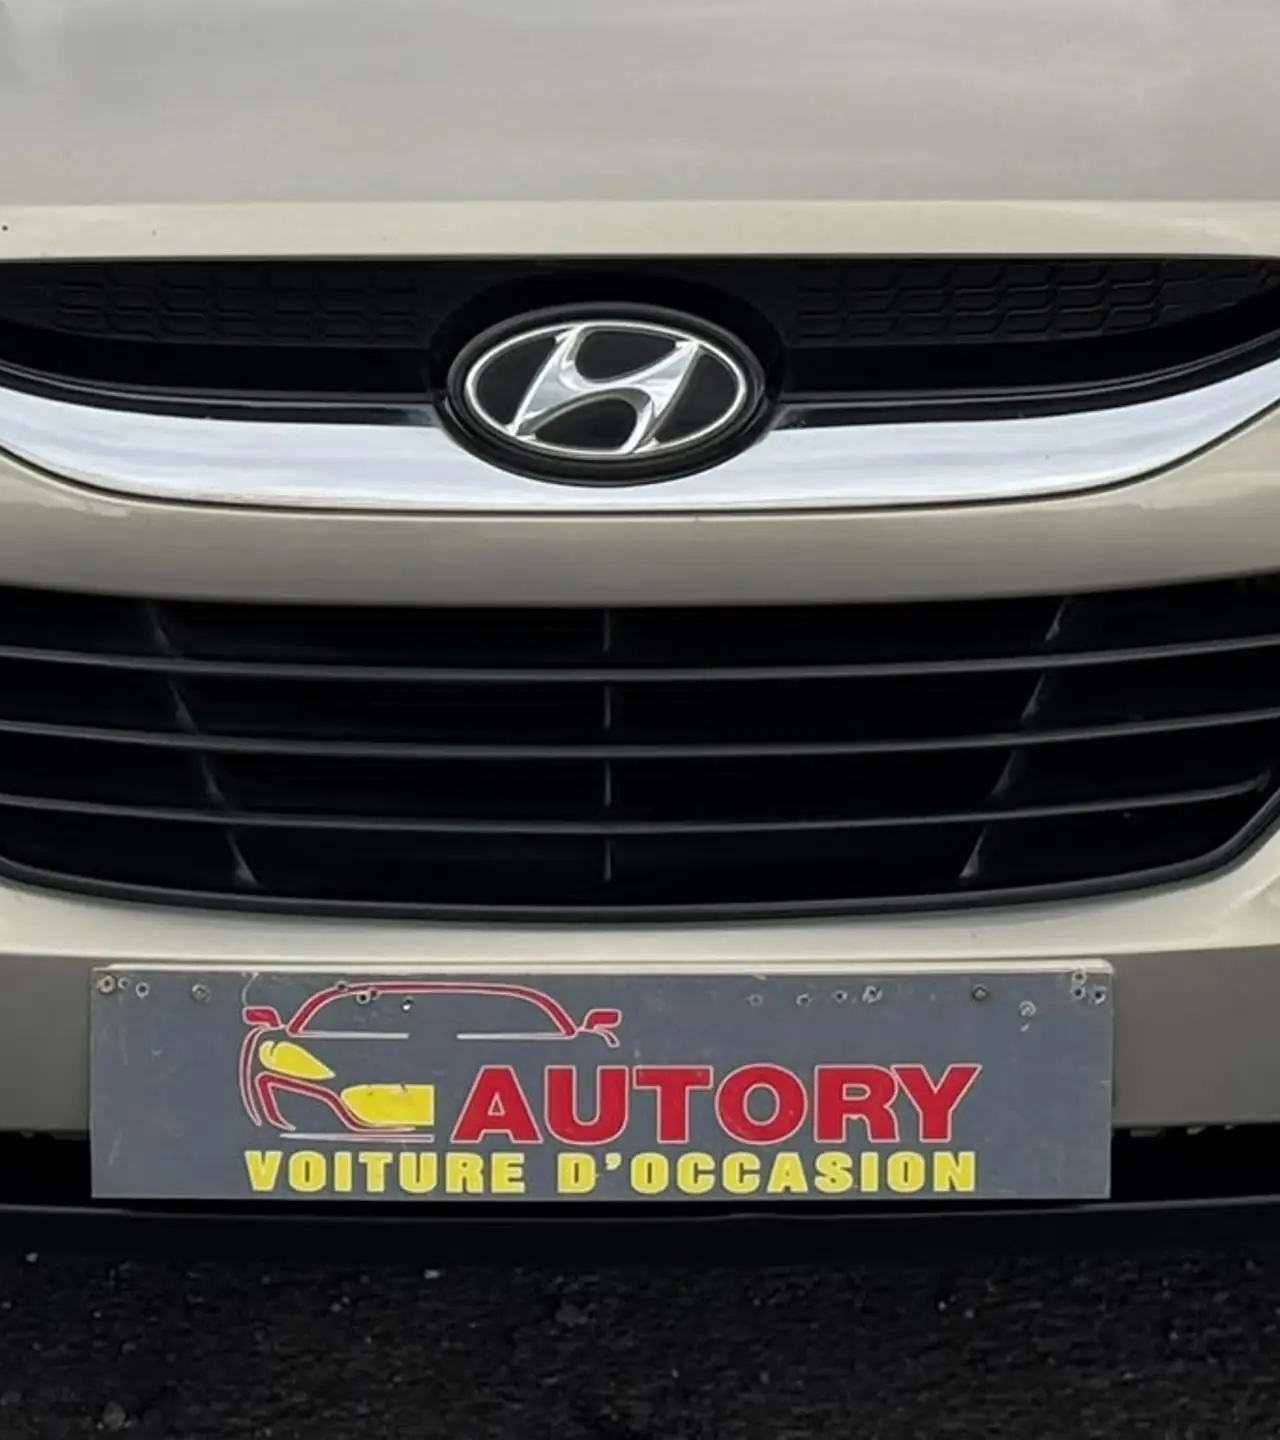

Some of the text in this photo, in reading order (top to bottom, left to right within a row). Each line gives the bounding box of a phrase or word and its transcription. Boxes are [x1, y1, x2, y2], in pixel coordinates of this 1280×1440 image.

[449, 1063, 982, 1145] AUTORY
[244, 1150, 975, 1194] VOITURE D'OCCASION
